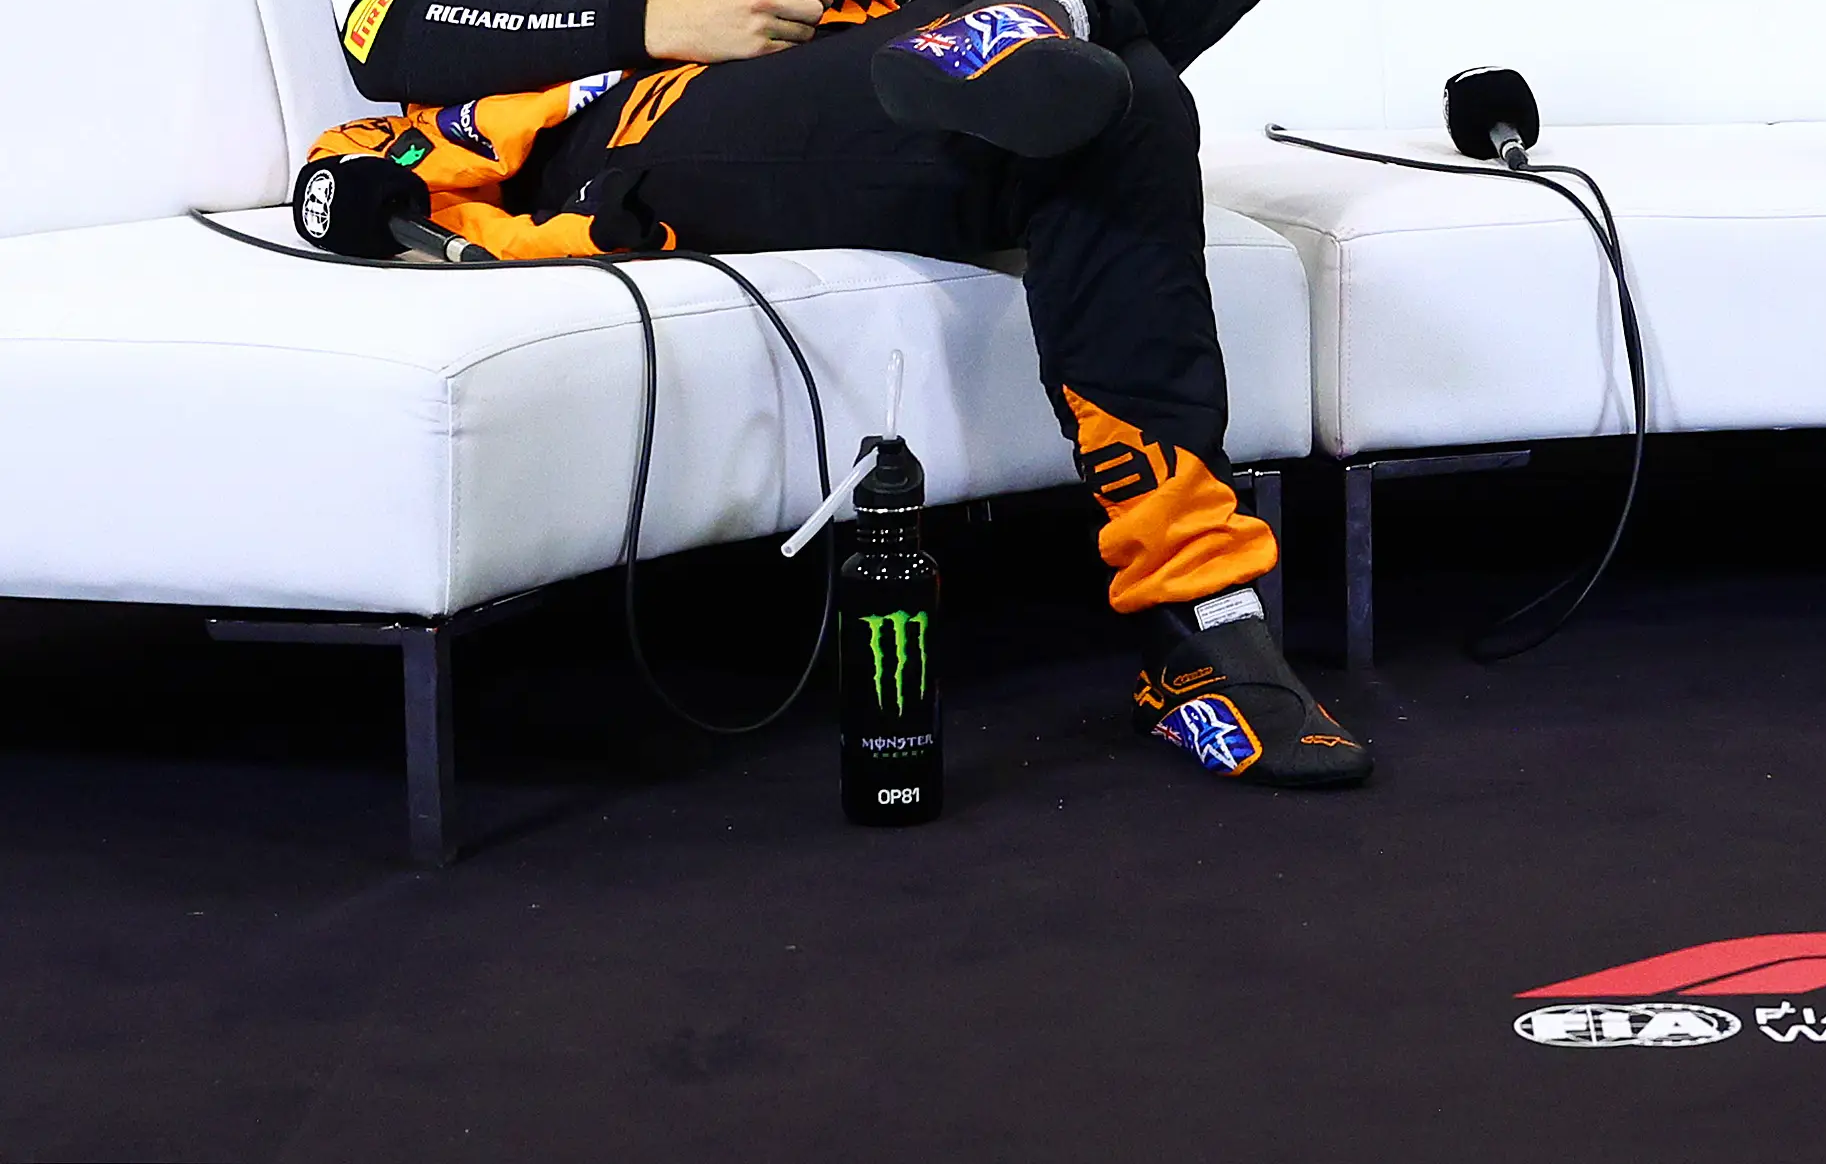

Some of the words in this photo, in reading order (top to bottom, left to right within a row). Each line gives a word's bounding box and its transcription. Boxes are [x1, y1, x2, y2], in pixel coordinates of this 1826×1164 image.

[425, 3, 525, 31] RICHARD
[527, 10, 596, 30] MILLE
[862, 733, 934, 751] MONSTER
[877, 787, 920, 805] OP81
[1514, 1003, 1742, 1047] FIA
